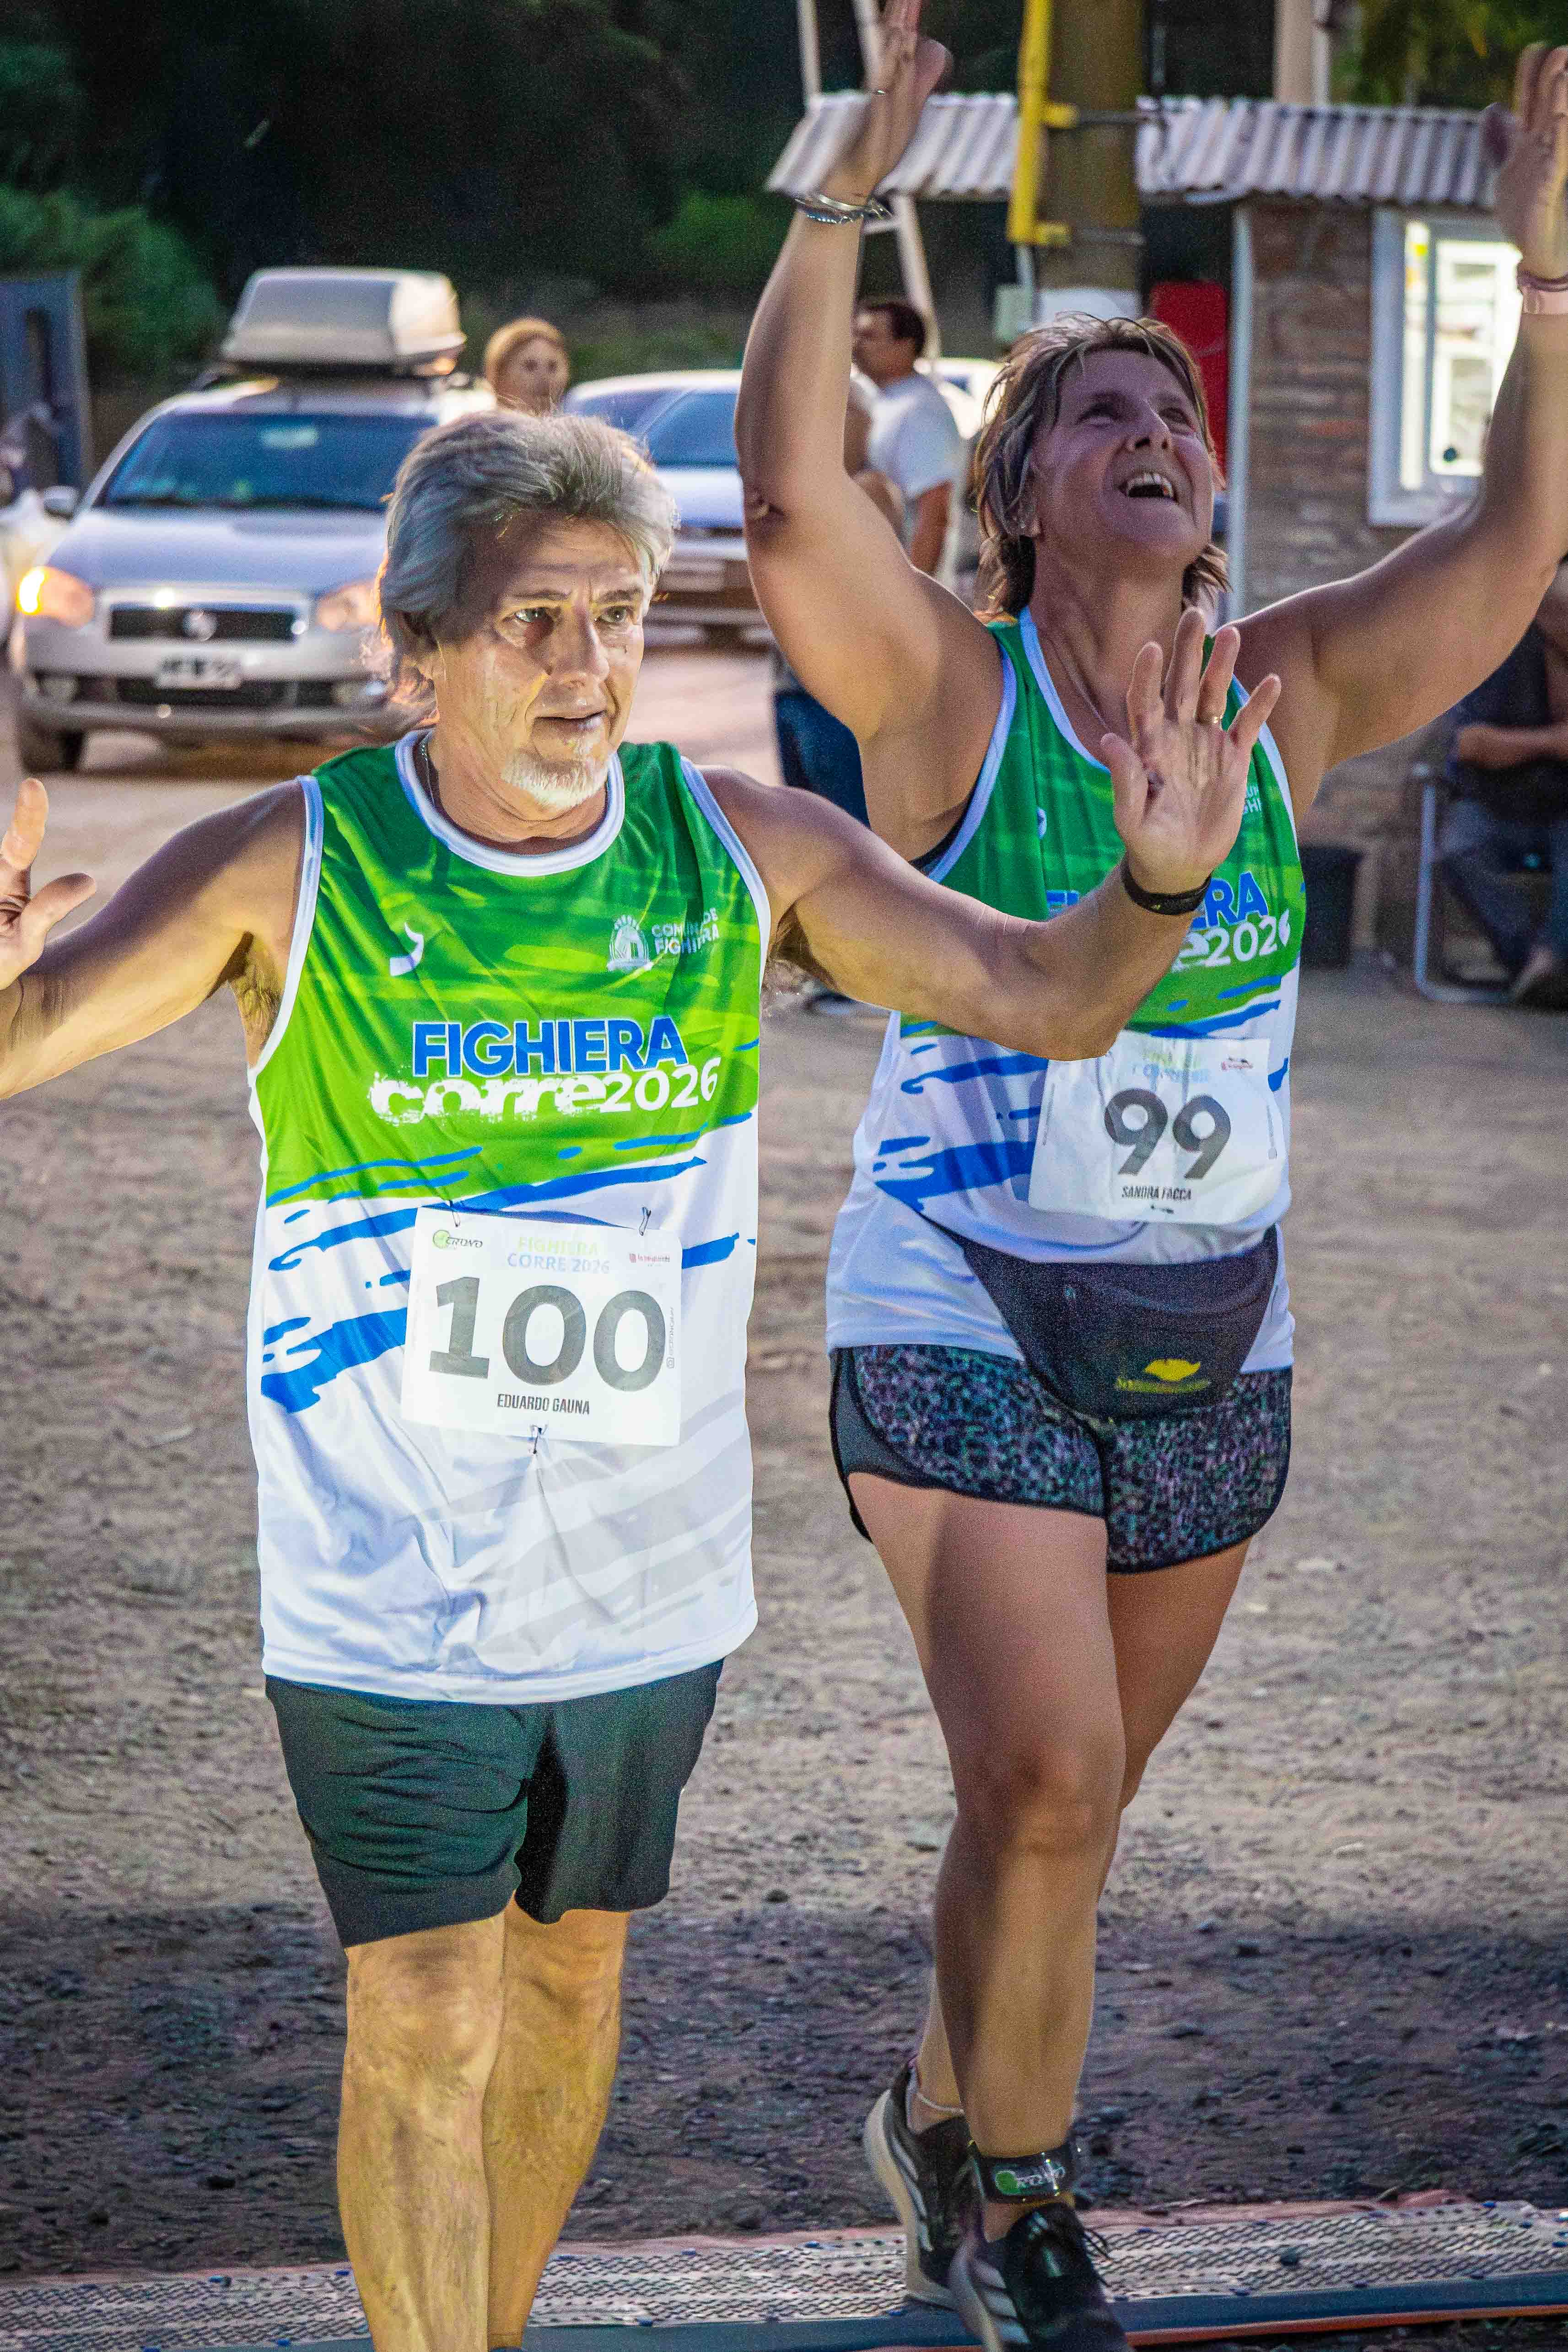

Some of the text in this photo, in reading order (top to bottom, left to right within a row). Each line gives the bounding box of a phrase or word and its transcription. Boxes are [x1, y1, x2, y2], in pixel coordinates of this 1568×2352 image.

[412, 1015, 689, 1077] FIGHIERA
[1104, 1087, 1231, 1180] 99
[1121, 1185, 1159, 1199] SANDRA
[507, 1252, 610, 1275] CORRE 2026
[429, 1276, 666, 1393] 100
[497, 1393, 590, 1415] EDUARDO GAUNA
